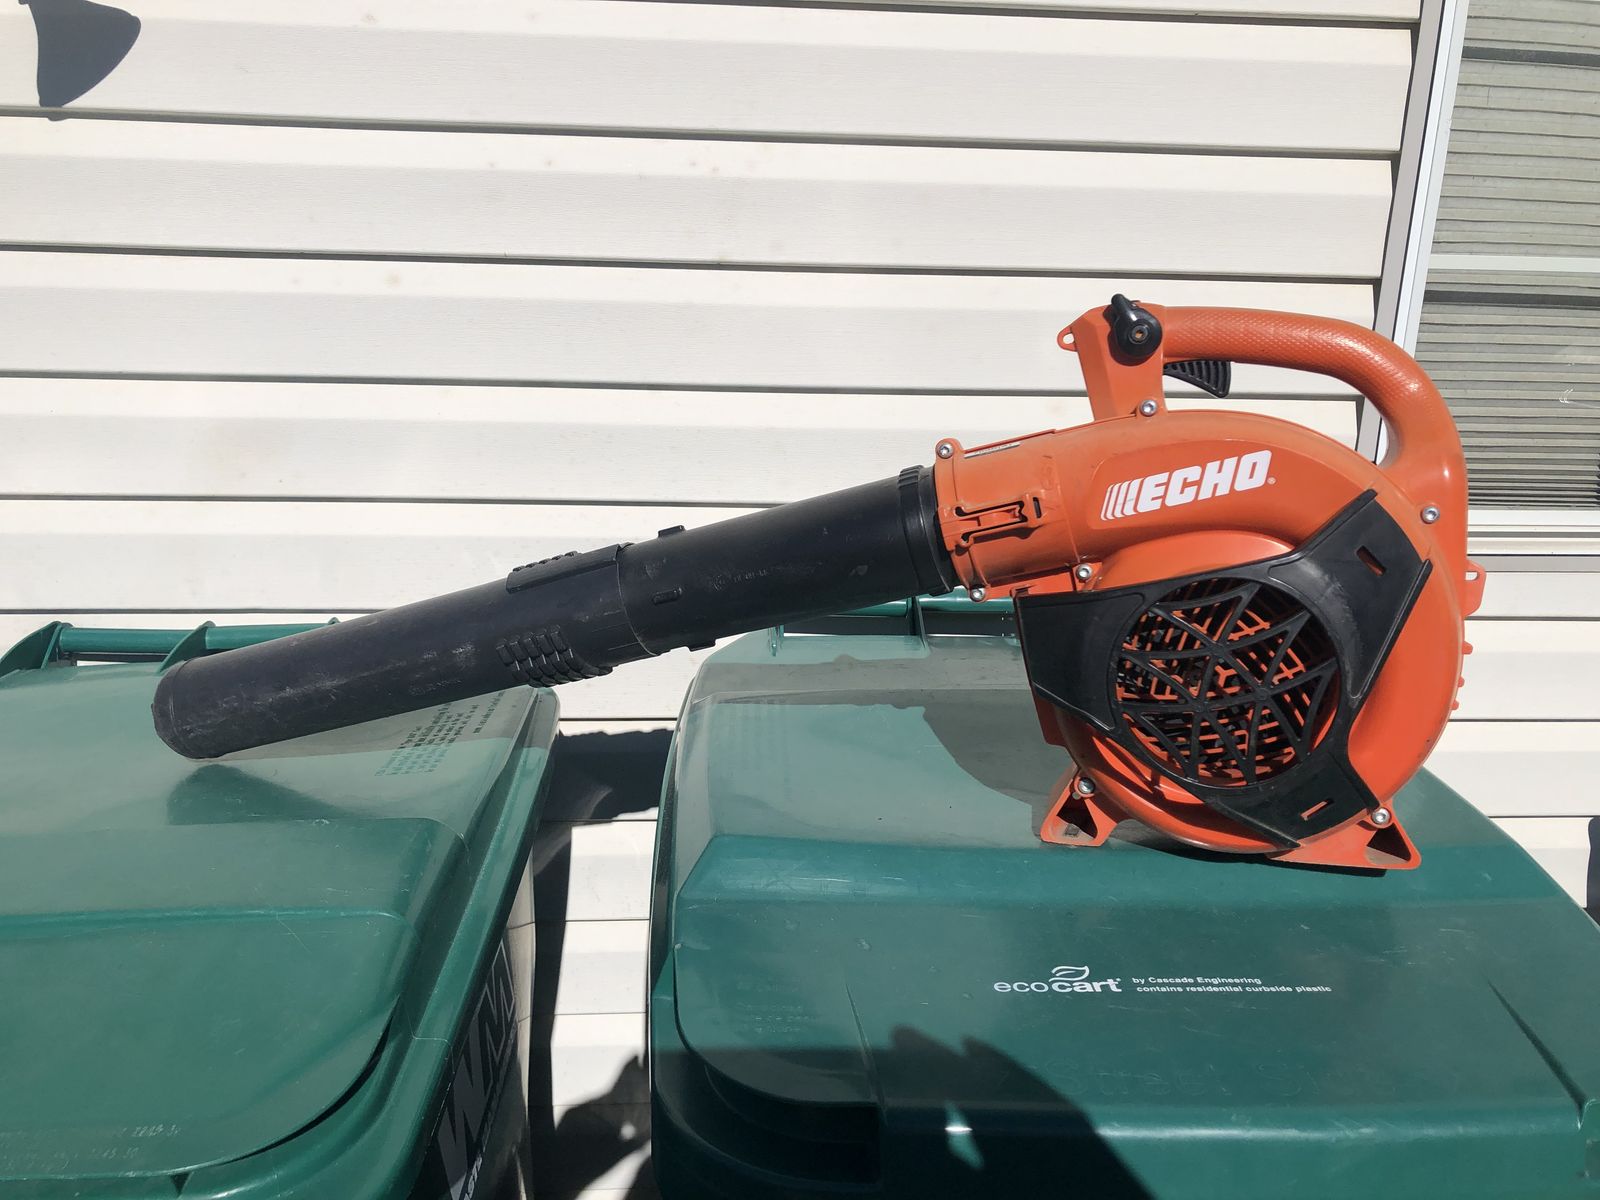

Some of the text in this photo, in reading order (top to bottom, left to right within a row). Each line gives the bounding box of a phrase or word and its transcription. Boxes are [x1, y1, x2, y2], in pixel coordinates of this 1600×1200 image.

[1134, 449, 1272, 514] ECHO
[1131, 976, 1263, 985] by Cascade Engineering
[1136, 985, 1333, 993] contains residential curbside plastic
